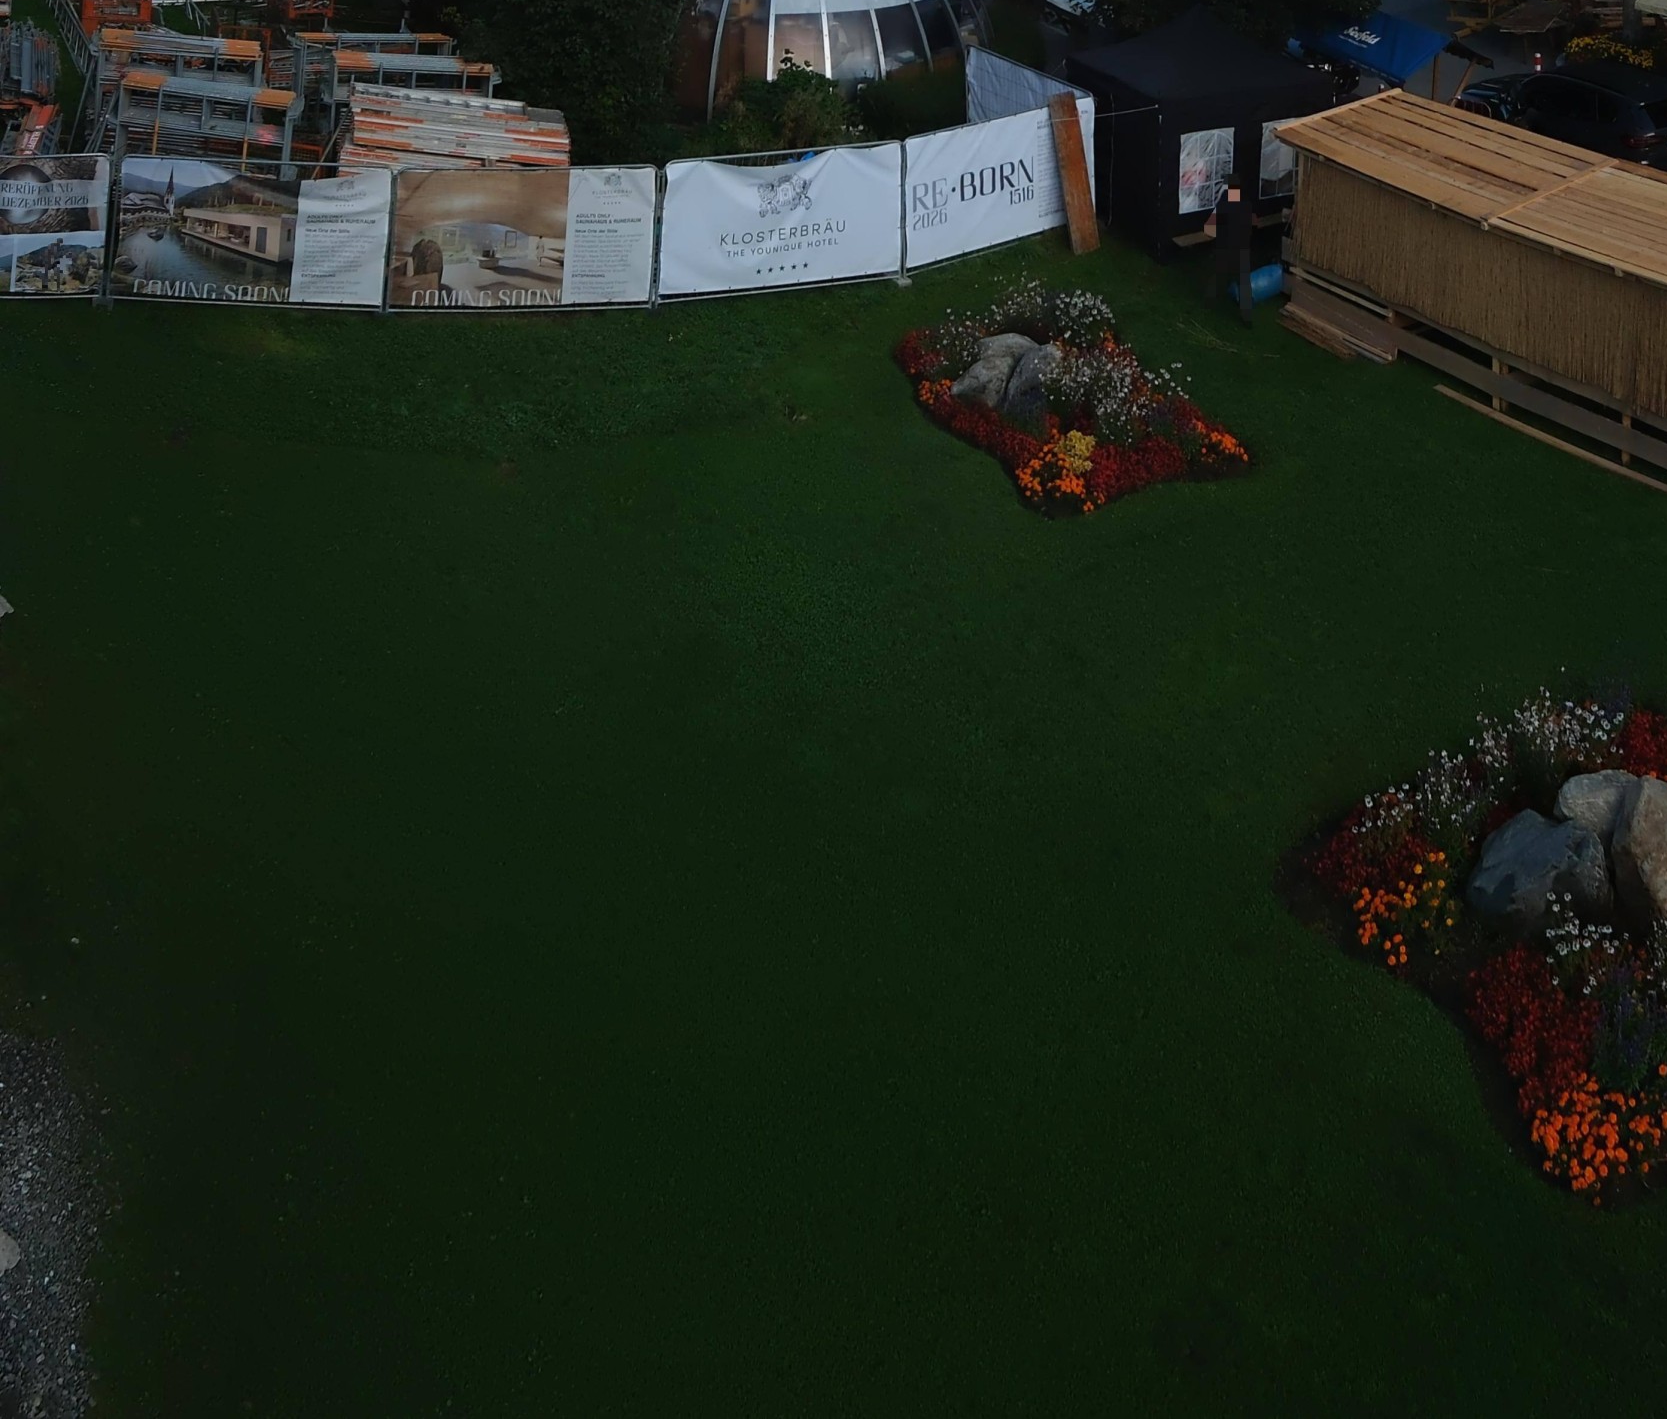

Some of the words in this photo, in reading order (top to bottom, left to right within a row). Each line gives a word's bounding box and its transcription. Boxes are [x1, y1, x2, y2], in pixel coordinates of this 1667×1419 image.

[65, 194, 89, 205] 2026
[1010, 184, 1034, 205] 1516
[912, 207, 948, 231] 2026
[720, 219, 846, 246] KLOSTERBRÄU
[727, 249, 745, 257] THE
[750, 242, 802, 255] YOUNIQUE
[807, 238, 838, 249] HOTEL
[133, 279, 217, 299] COMING
[411, 289, 494, 306] COMING
